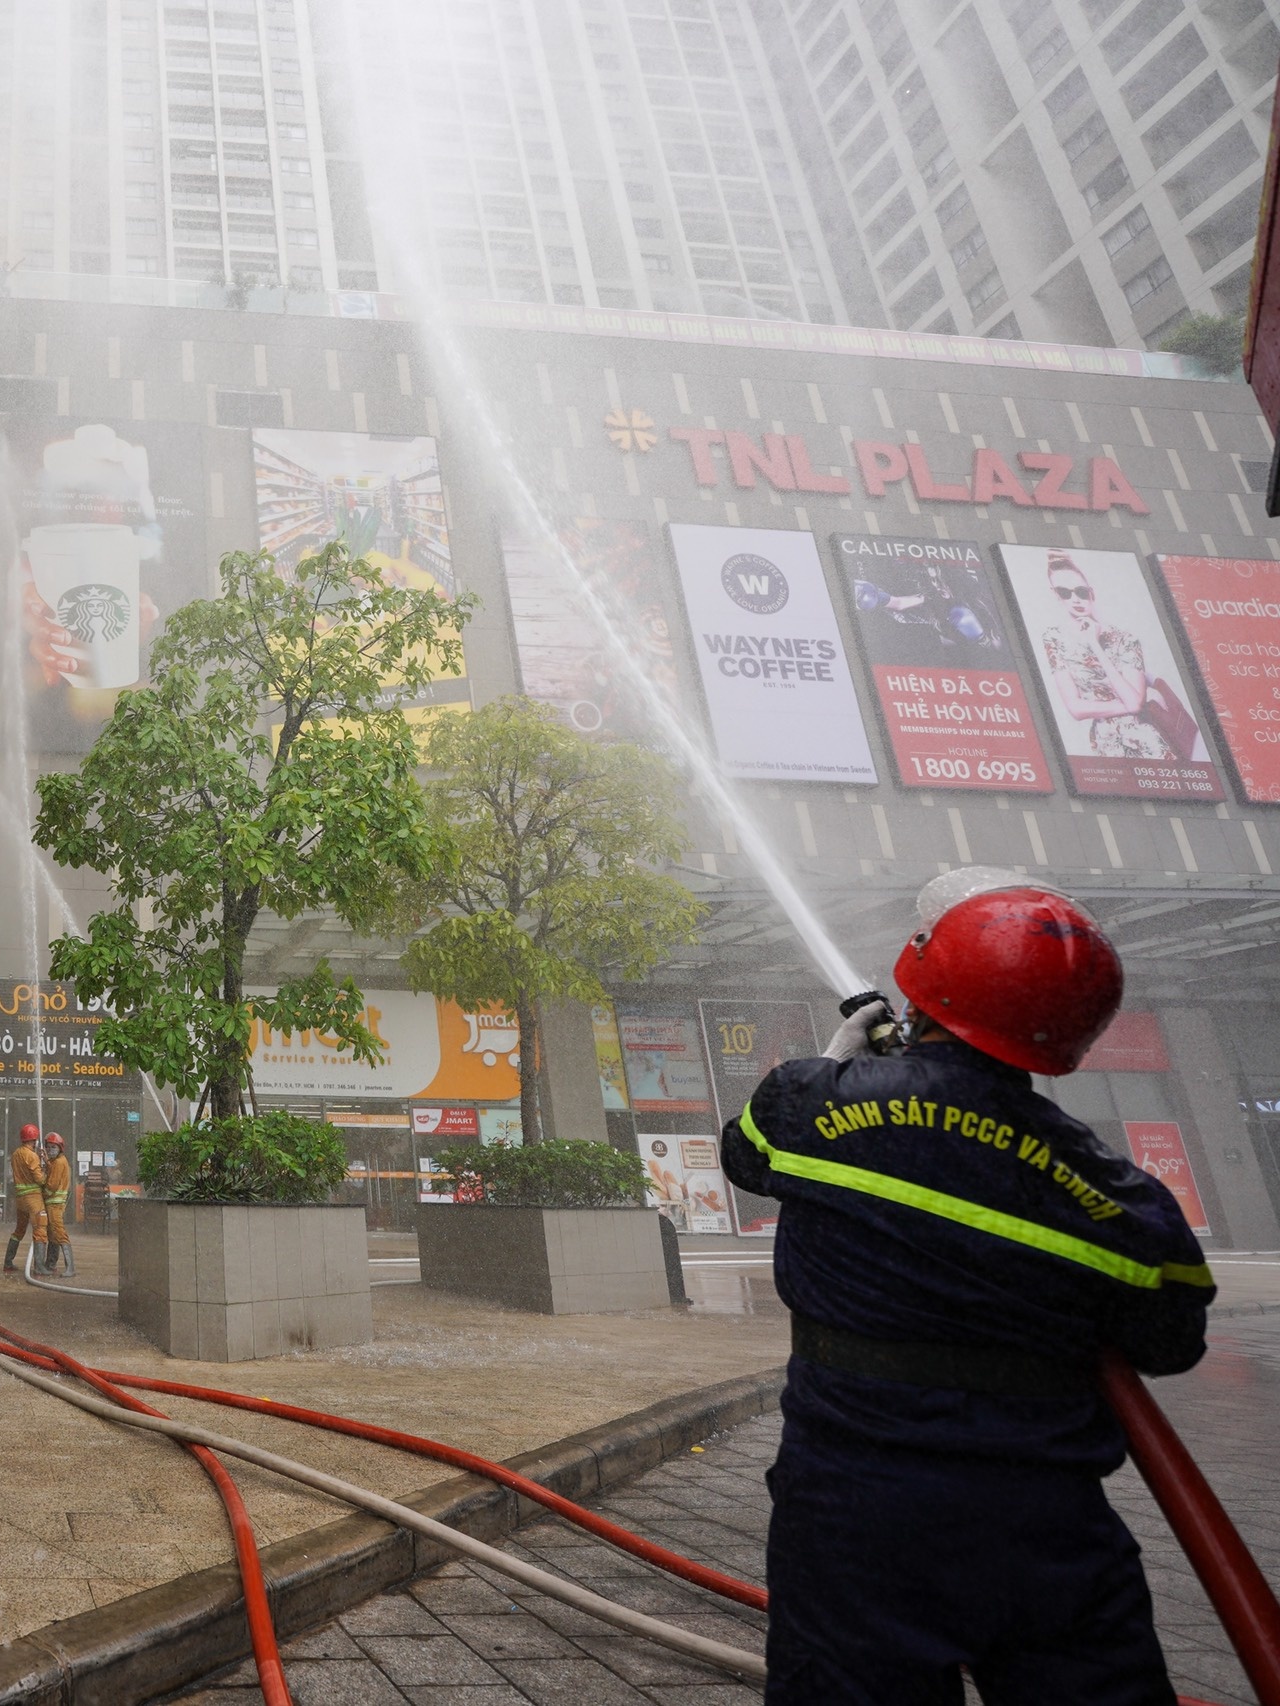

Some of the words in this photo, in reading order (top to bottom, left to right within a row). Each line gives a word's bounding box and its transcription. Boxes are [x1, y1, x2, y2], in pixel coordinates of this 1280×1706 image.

[669, 426, 850, 495] TNL
[851, 439, 1153, 517] PLAZA
[841, 540, 980, 562] CALIFORNIA
[737, 574, 770, 596] W
[717, 656, 835, 682] COFFEE
[886, 673, 936, 696] HIỆN
[941, 675, 974, 695] ĐÃ
[978, 678, 1012, 697] CÓ
[893, 697, 930, 719] THẺ
[934, 701, 973, 724] HỘI
[974, 704, 1021, 724] VIÊN
[900, 725, 958, 735] MEMBERSHIPS
[959, 728, 980, 736] NOW
[983, 729, 1026, 738] AVAILABLE
[1254, 726, 1280, 743] củ
[947, 747, 989, 757] HOTLINE
[910, 757, 970, 779] 1800
[977, 760, 1036, 782] 6995
[1134, 767, 1156, 776] 096
[1157, 768, 1178, 778] 324
[1181, 769, 1209, 779] 3663
[1138, 779, 1160, 789] 093
[1161, 780, 1182, 790] 221
[1186, 781, 1214, 792] 1688
[18, 1060, 61, 1076] Hopot
[73, 1061, 123, 1076] Seafood
[263, 1053, 315, 1064] Service
[322, 1054, 352, 1065] Your
[814, 1100, 885, 1140] CẢNH
[888, 1096, 938, 1127] SÁT
[943, 1106, 1014, 1150] PCCC
[1017, 1134, 1052, 1171] VÀ
